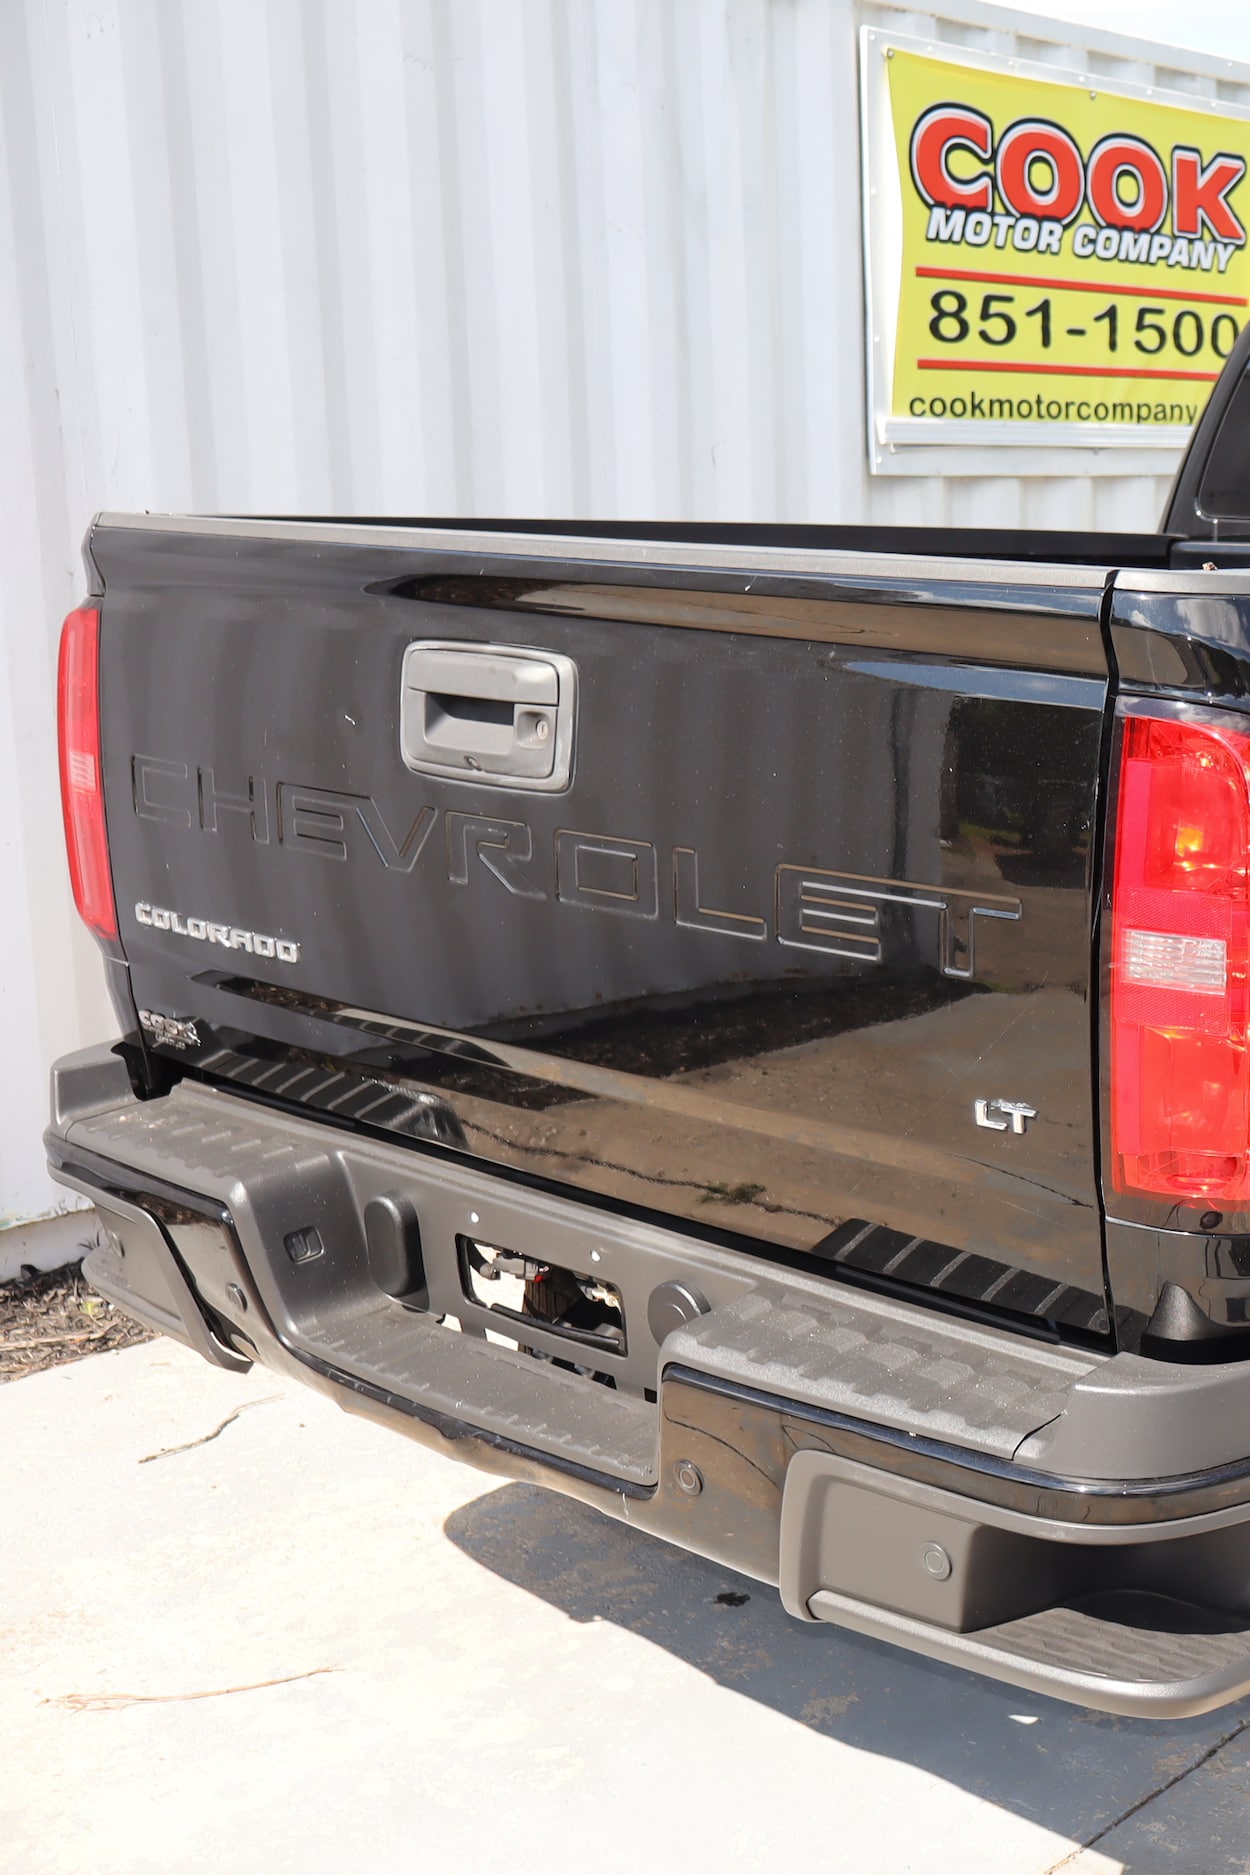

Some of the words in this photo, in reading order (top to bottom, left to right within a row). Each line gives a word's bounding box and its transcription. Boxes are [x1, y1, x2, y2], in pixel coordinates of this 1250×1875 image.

[909, 102, 1247, 249] COOK
[926, 206, 1063, 254] MOTOR
[1072, 225, 1238, 273] COMPANY
[928, 290, 1239, 358] 851-1500
[131, 754, 1022, 977] CHEVROLET
[134, 902, 299, 963] COLORADO
[975, 1099, 1037, 1134] LT
